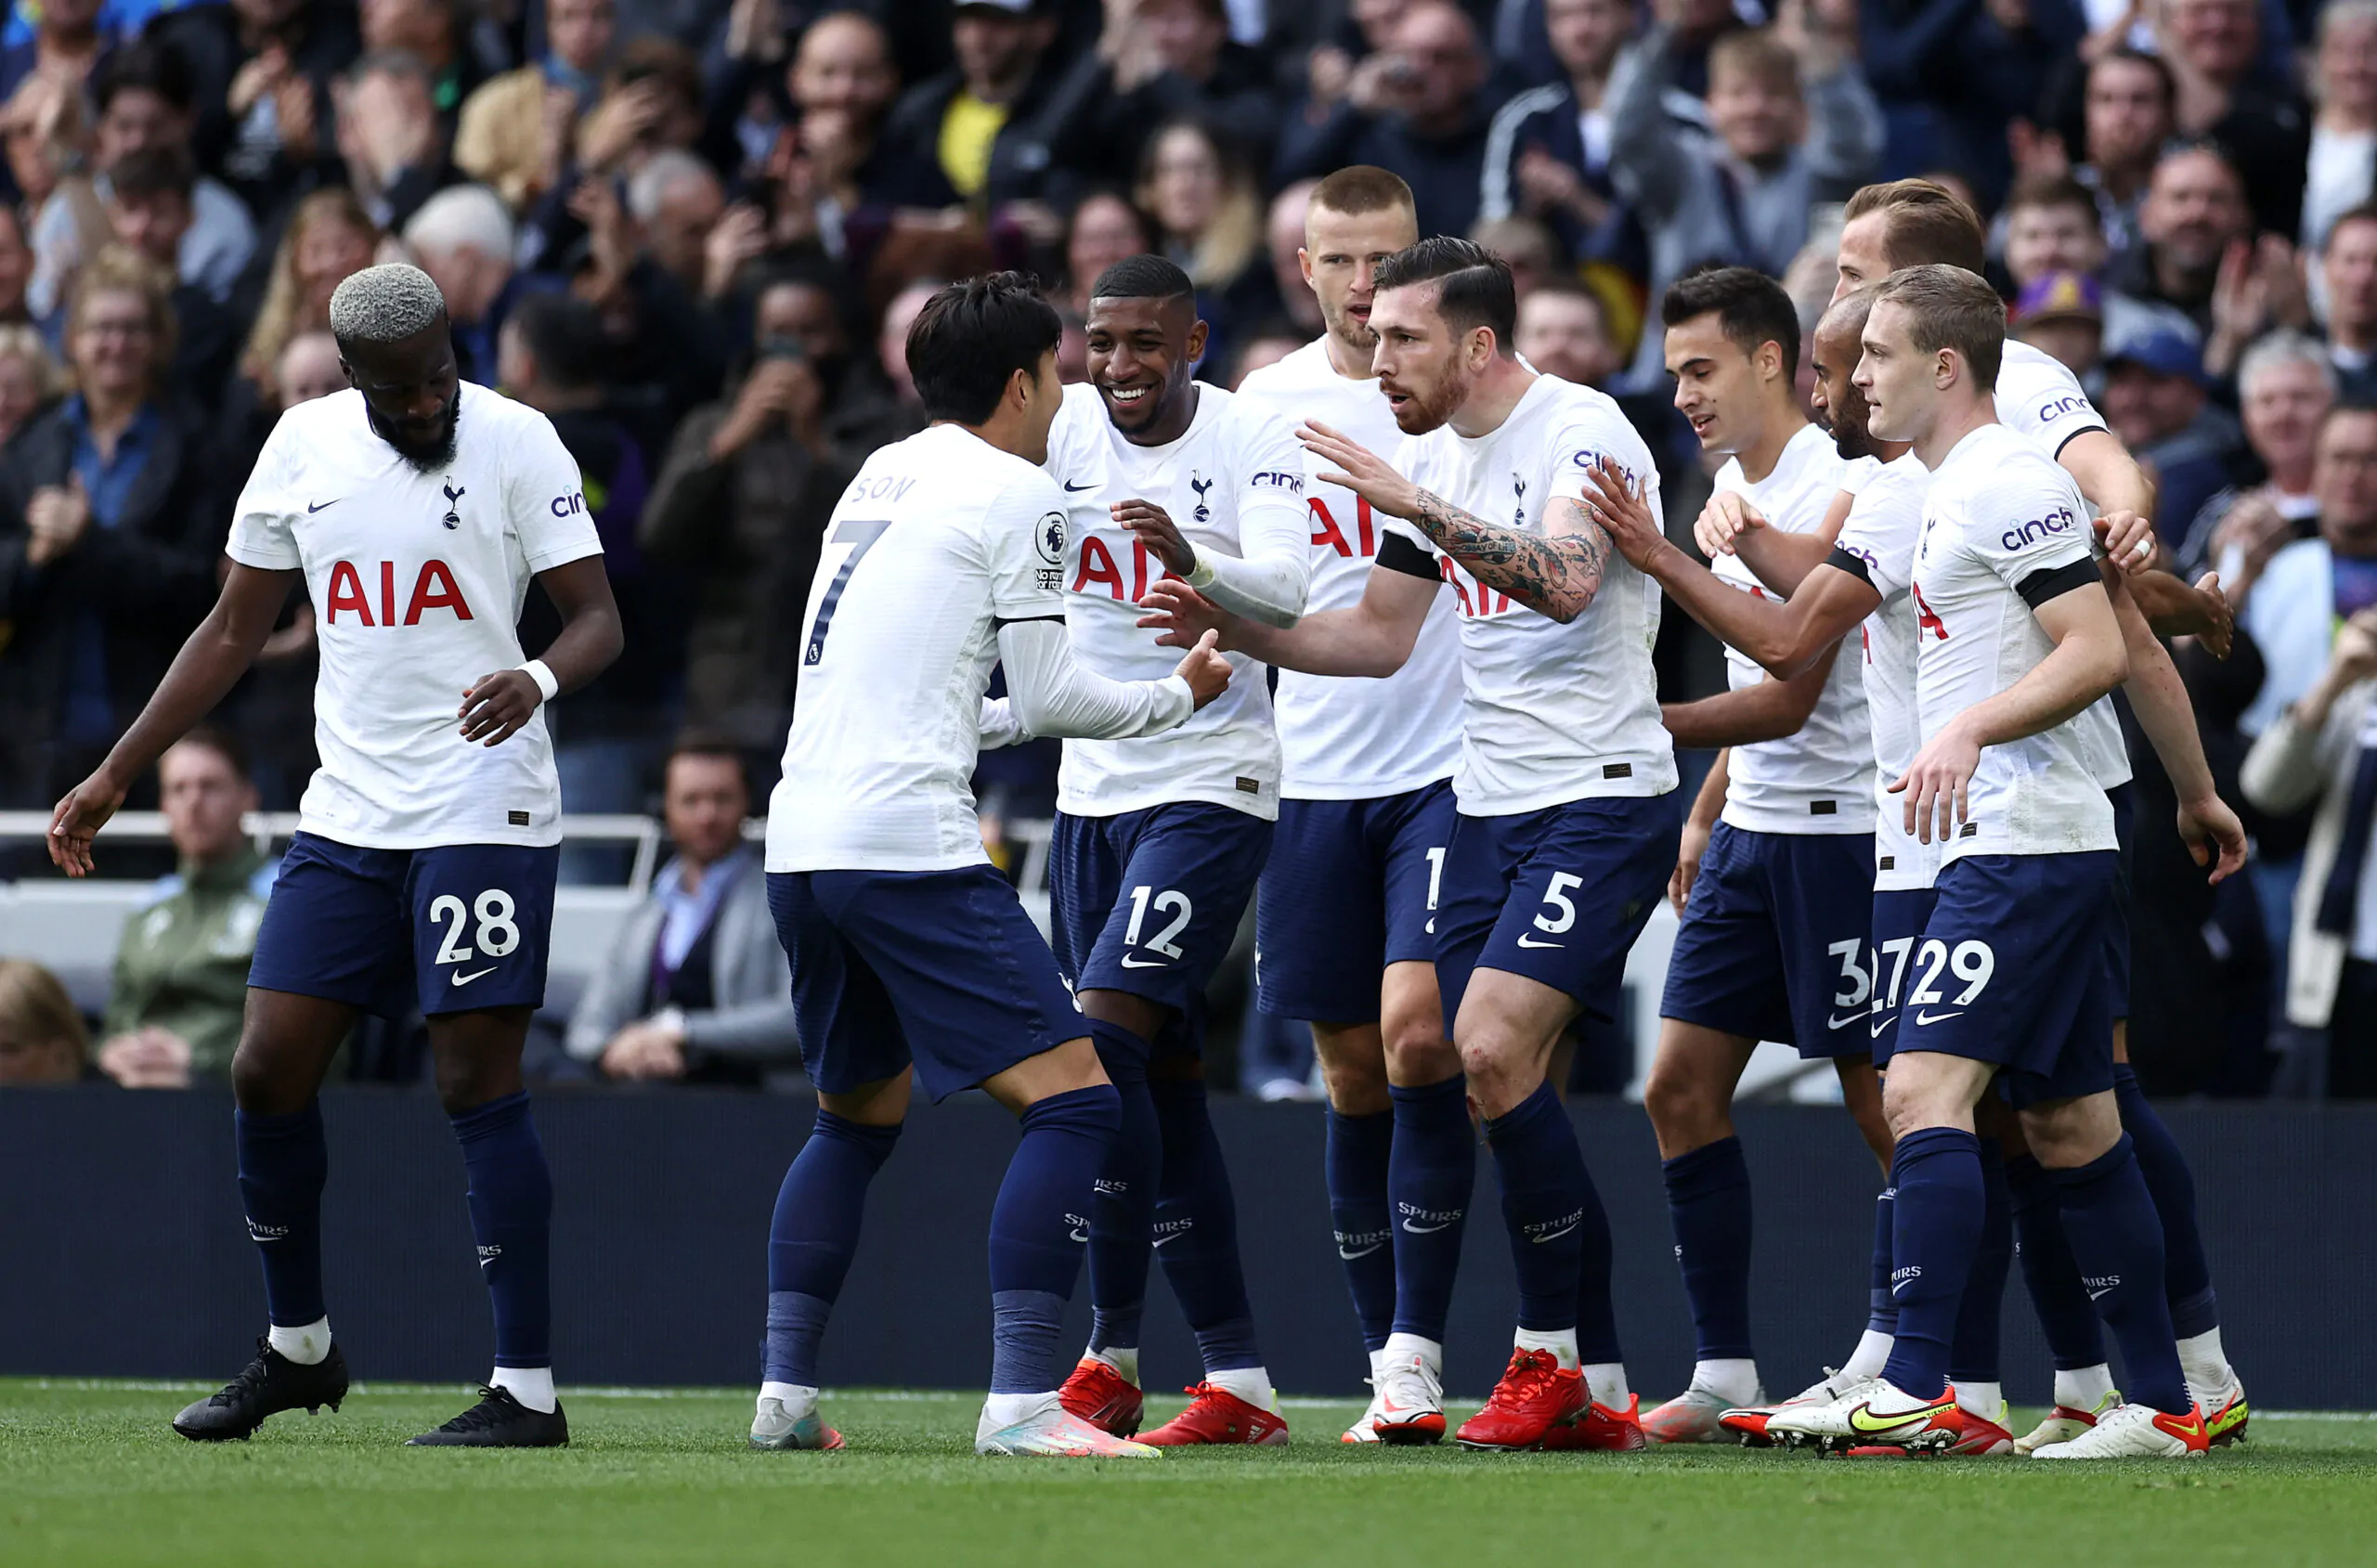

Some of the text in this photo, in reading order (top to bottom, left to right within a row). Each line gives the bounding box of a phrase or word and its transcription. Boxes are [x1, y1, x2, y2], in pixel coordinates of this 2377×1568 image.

[551, 485, 587, 518] cin
[851, 475, 907, 503] SON
[1306, 495, 1375, 557] AI
[2002, 507, 2073, 551] cinch
[328, 559, 474, 627] AIA
[804, 520, 892, 666] 7
[1035, 569, 1048, 580] No
[1072, 536, 1187, 603] AI
[430, 888, 520, 965] 28
[1124, 885, 1192, 960] 12
[1533, 871, 1583, 934] 5
[1828, 938, 1871, 1007] 3
[1907, 939, 1994, 1006] 29
[1397, 1201, 1462, 1222] SPURS
